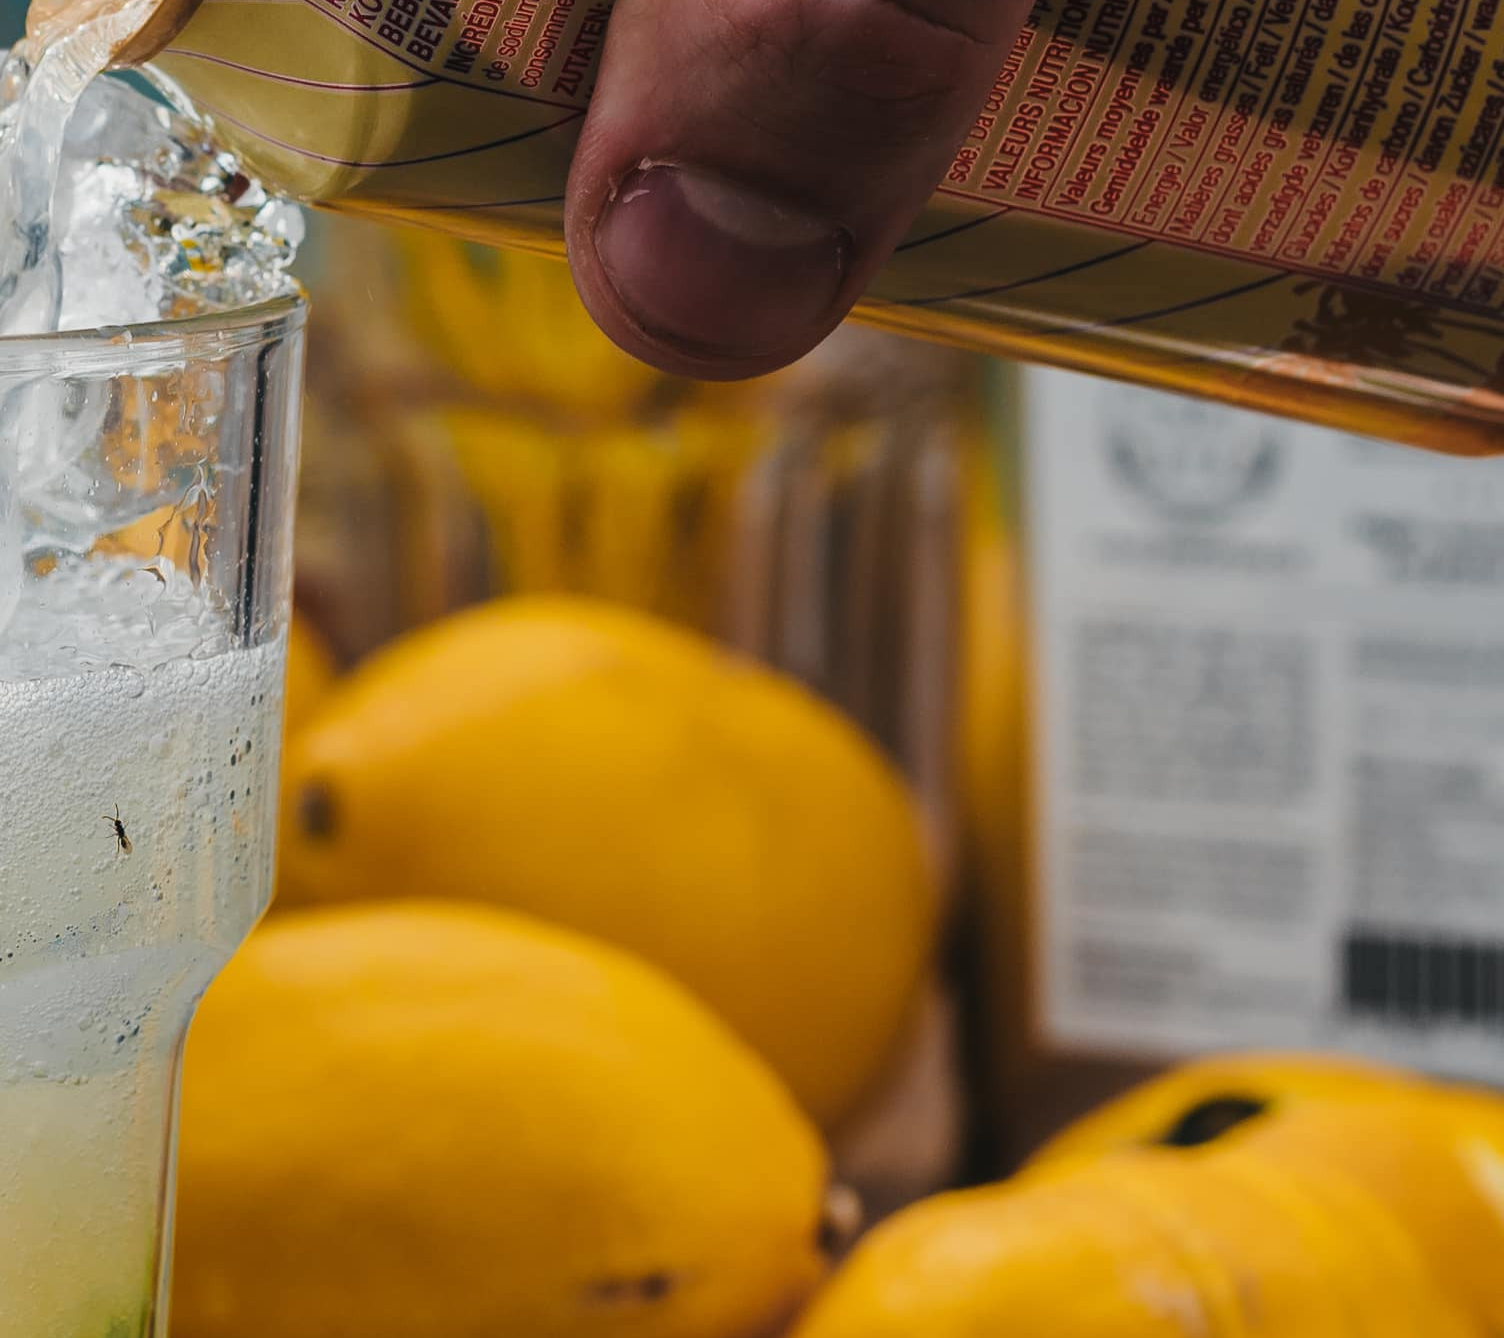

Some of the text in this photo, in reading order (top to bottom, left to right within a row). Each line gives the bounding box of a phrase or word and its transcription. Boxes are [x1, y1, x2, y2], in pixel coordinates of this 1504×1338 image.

[481, 58, 510, 82] de
[552, 0, 613, 96] ZUTATEN:
[1331, 40, 1362, 71] de
[1342, 9, 1374, 41] las
[1055, 141, 1107, 209] Valeurs
[1094, 40, 1155, 140] moyennes
[1142, 3, 1169, 40] par
[1089, 107, 1160, 217] Gemiddelde
[1150, 33, 1193, 107] waarde
[1131, 161, 1182, 227] Energie
[1168, 104, 1210, 152] Valor
[1197, 4, 1253, 104] energético
[1437, 44, 1483, 114] Zucker
[981, 100, 1044, 194] VALEURS
[1169, 164, 1224, 235] Matières
[1212, 92, 1259, 165] grasses
[1243, 40, 1280, 79] Fett
[1208, 206, 1244, 245] dont
[1232, 149, 1273, 206] acides
[1262, 106, 1296, 151] gras
[1248, 162, 1308, 252] verzadigde
[1358, 177, 1385, 201] de
